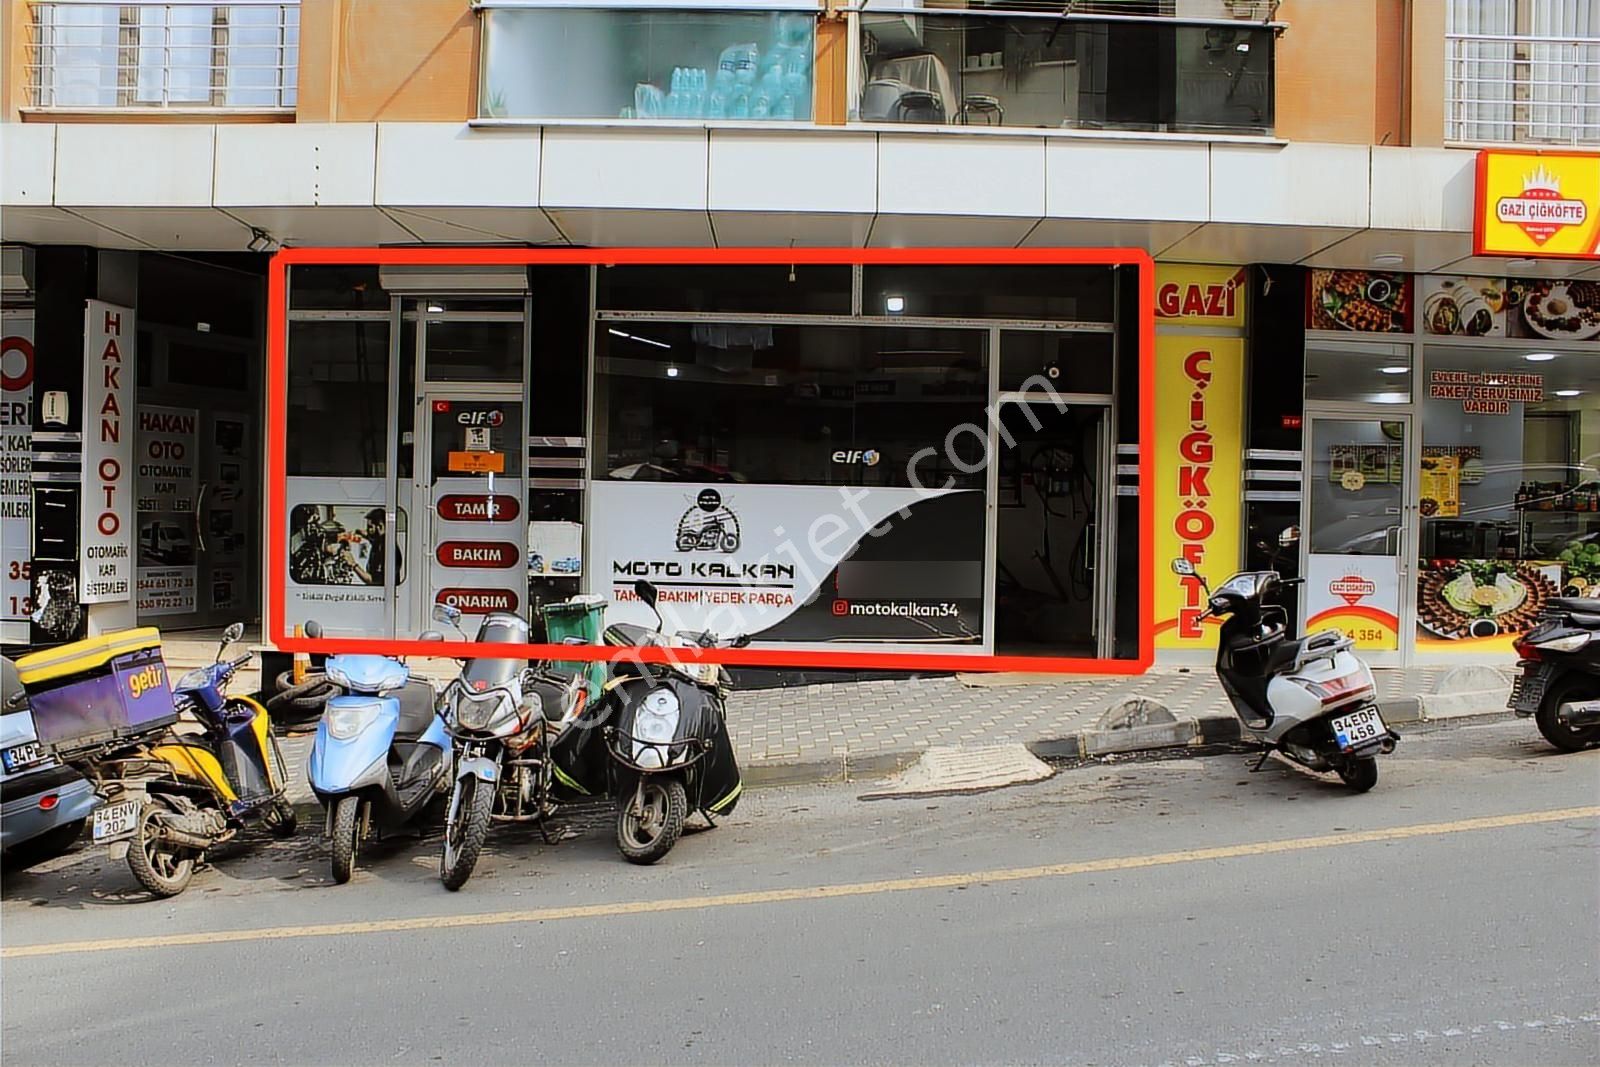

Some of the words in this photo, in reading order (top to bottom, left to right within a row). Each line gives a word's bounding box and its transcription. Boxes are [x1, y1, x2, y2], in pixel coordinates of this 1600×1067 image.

[1500, 201, 1526, 217] GAZİ
[1528, 201, 1583, 220] ÇİĞKÖFTE
[1157, 277, 1236, 318] GAZİ
[101, 310, 122, 443] HAKAN
[1431, 385, 1470, 399] PAKET
[140, 412, 195, 433] HAKAN
[457, 411, 487, 425] elf
[148, 440, 185, 460] OTO
[832, 450, 863, 464] elf
[97, 458, 121, 536] OTO
[1174, 351, 1214, 638] ÇİĞKÖFTE
[454, 502, 501, 515] TAMR
[453, 548, 502, 561] BAKIM
[613, 560, 682, 577] MOTO
[691, 561, 794, 579] KALKAN
[446, 595, 508, 608] ONARIM
[613, 589, 653, 601] TAM
[658, 590, 699, 603] BAKIM
[704, 591, 746, 604] YEDEK
[750, 592, 793, 607] PARÇA
[850, 602, 959, 617] motokalkan34
[1359, 629, 1383, 641] 354
[128, 665, 162, 699] getir
[1350, 724, 1376, 741] 458
